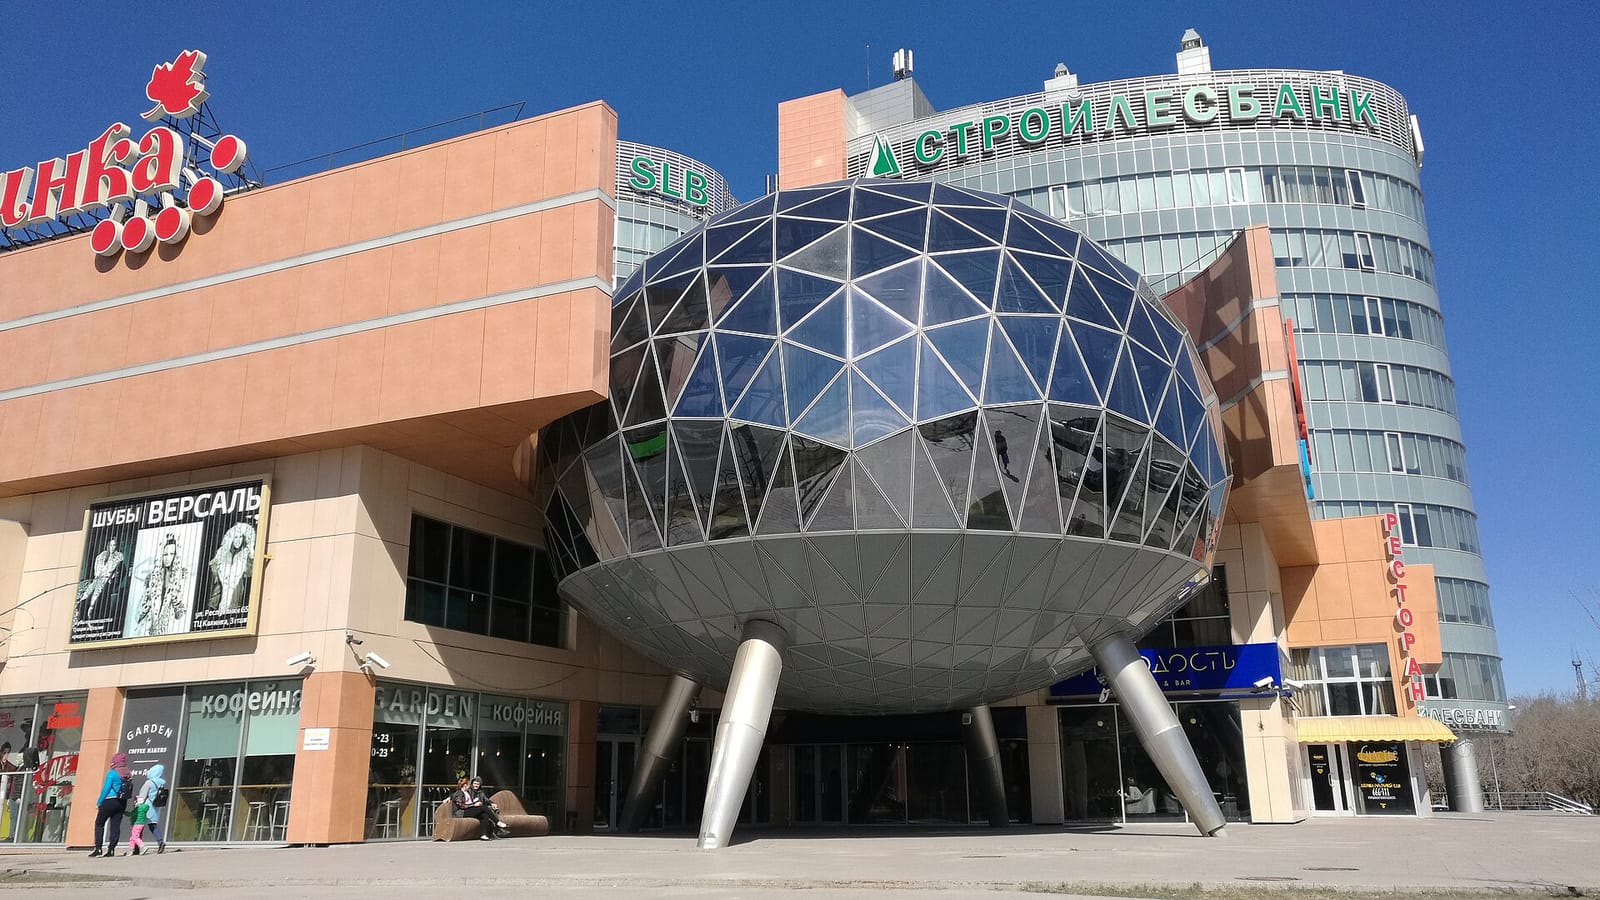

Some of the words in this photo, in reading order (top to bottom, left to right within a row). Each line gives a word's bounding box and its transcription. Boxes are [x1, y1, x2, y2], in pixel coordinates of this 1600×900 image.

[913, 83, 1382, 166] СТРОЙЛЕСБАНК
[628, 155, 709, 207] SLB
[92, 507, 141, 528] ШУБЫ
[147, 487, 261, 525] ВЕРСАЛЬ
[1383, 513, 1426, 701] РЕСТОРАН
[201, 683, 301, 718] кофейня
[1175, 679, 1191, 687] BAR
[375, 686, 473, 719] GARDEN
[493, 702, 562, 728] кофейня
[126, 723, 173, 741] GARDEN
